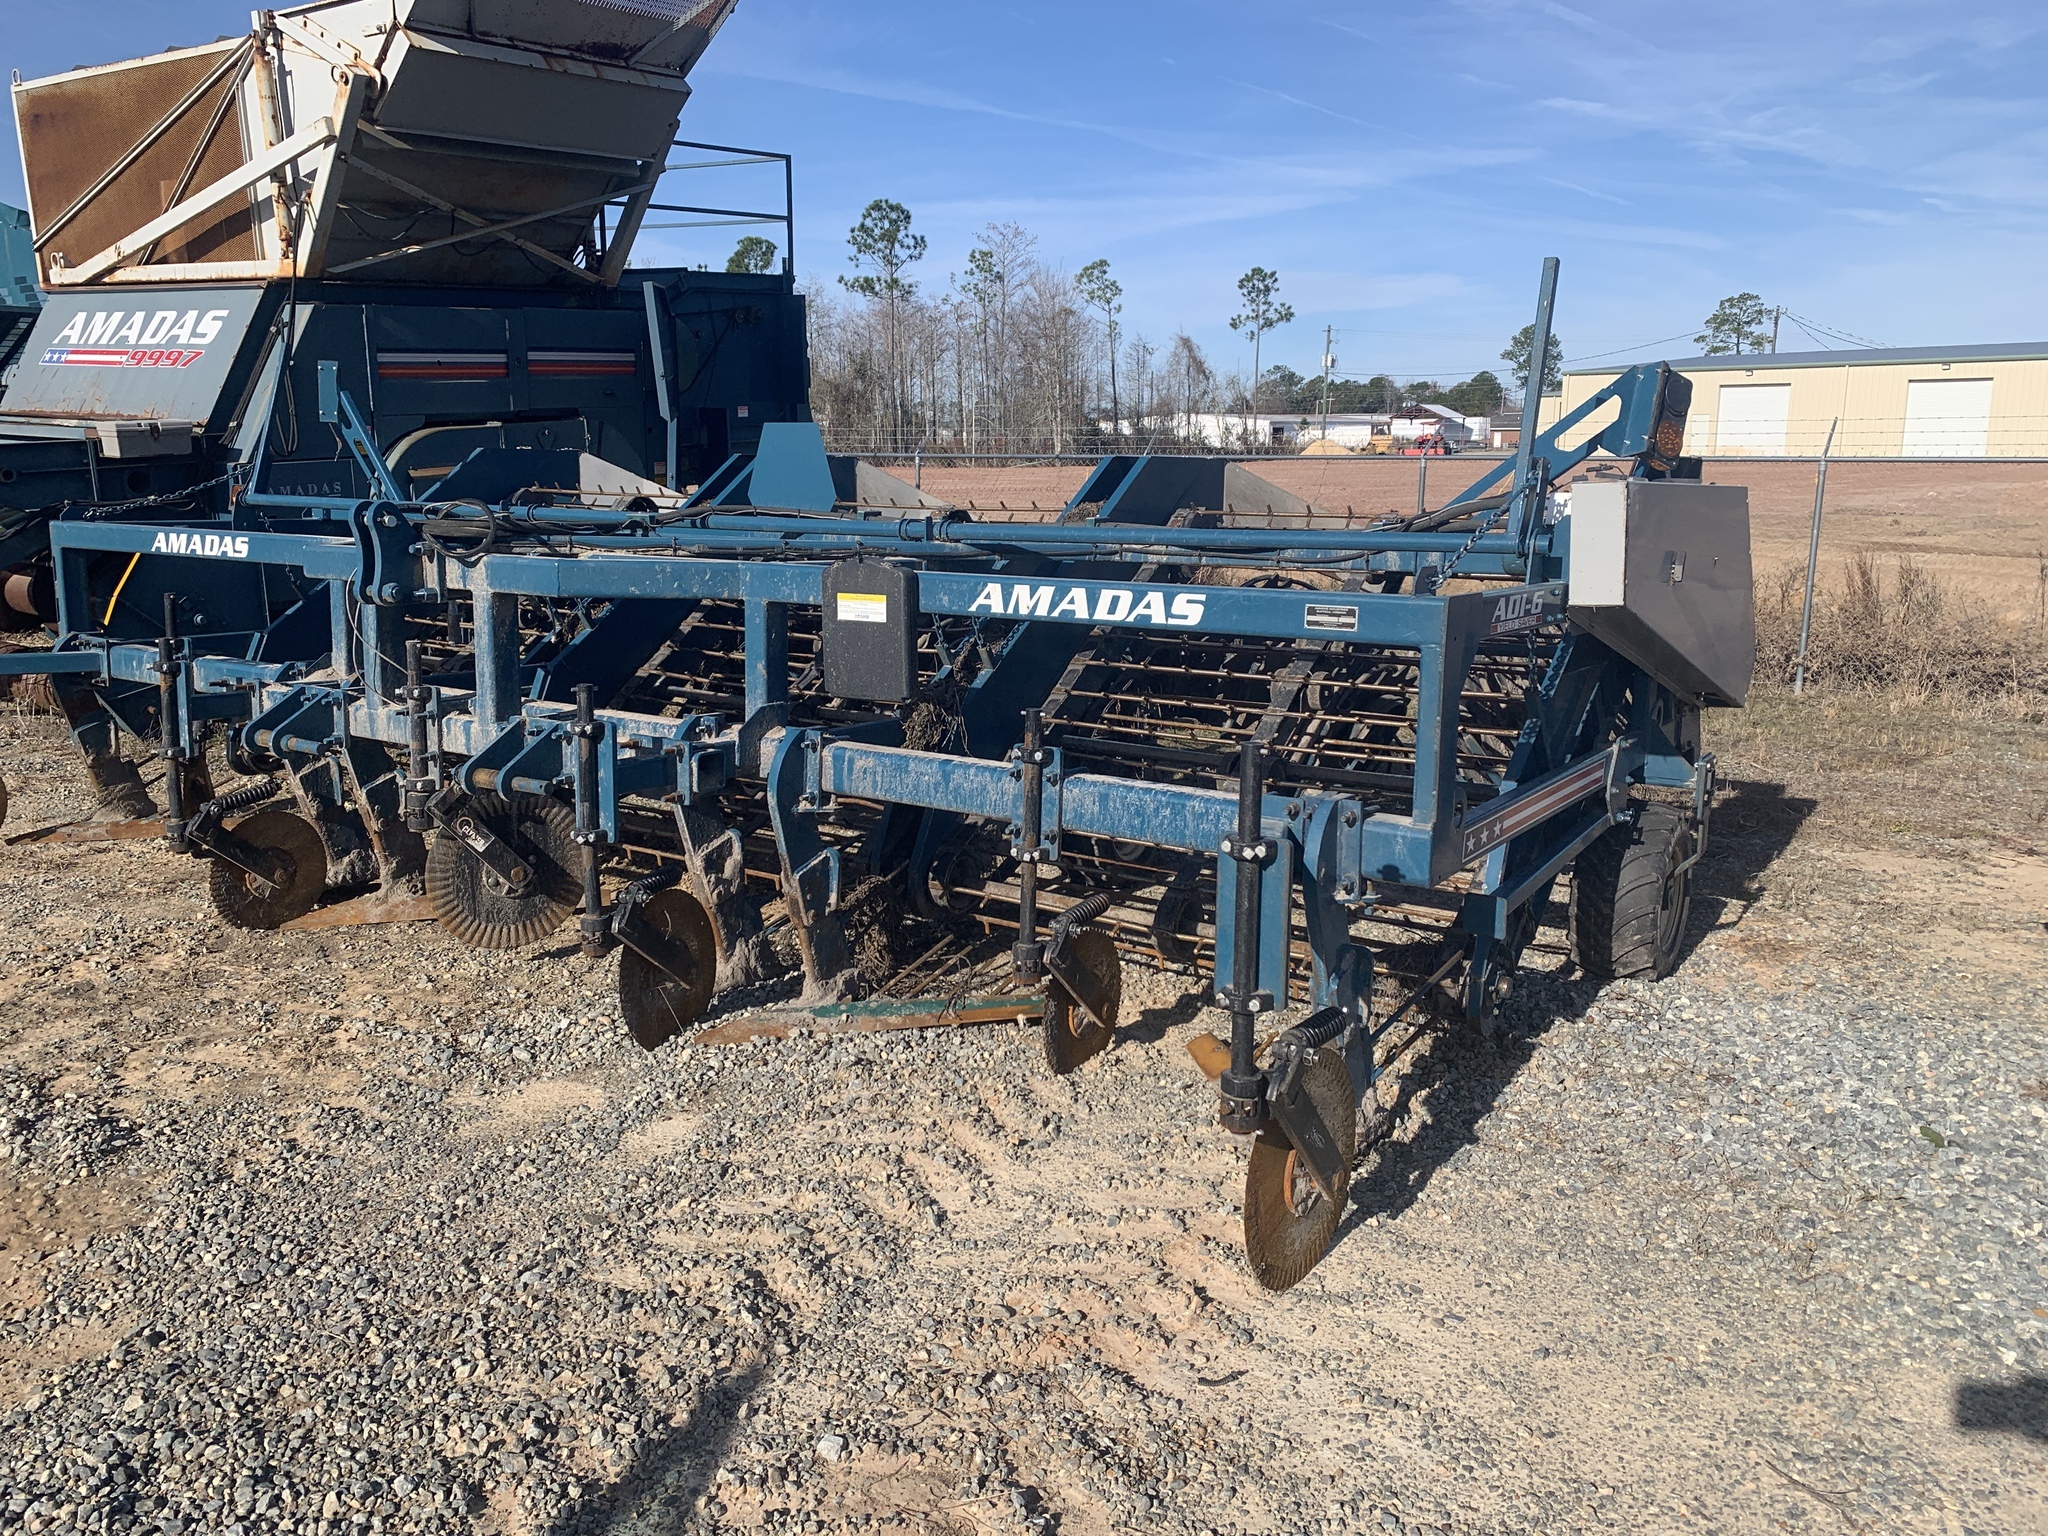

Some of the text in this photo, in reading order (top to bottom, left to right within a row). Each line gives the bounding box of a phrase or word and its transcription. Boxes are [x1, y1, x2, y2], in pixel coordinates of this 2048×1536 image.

[52, 310, 229, 345] AMADAS
[124, 349, 205, 368] 9997
[267, 482, 342, 496] AMADAS
[151, 532, 249, 558] AMADAS
[968, 583, 1206, 626] AMADAS
[1491, 591, 1544, 623] ADI-6
